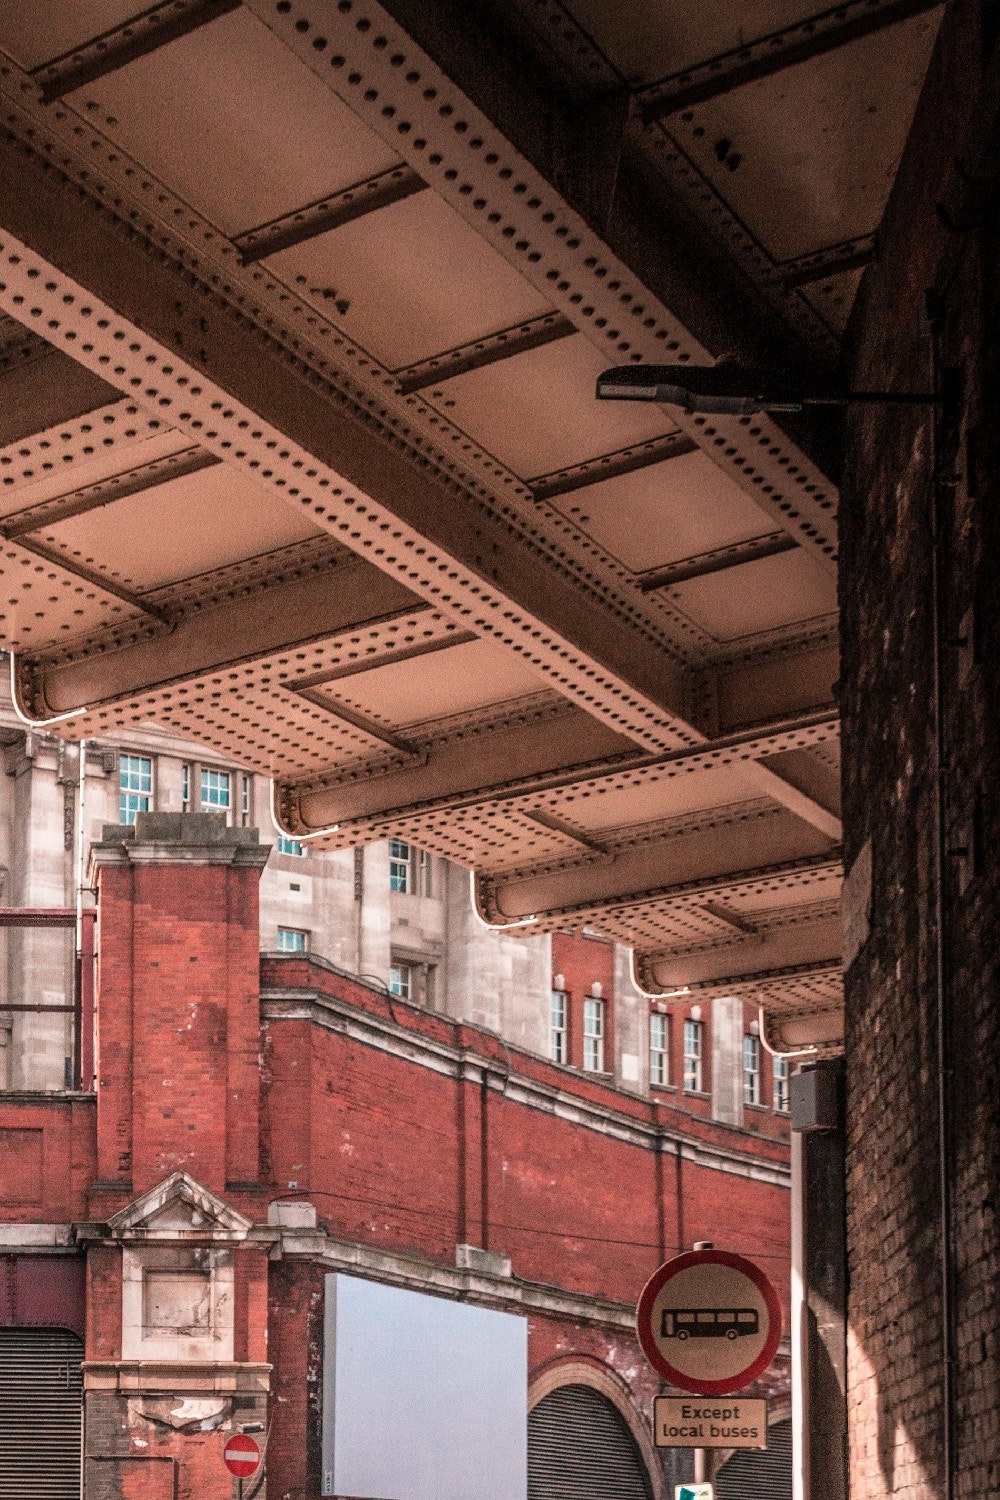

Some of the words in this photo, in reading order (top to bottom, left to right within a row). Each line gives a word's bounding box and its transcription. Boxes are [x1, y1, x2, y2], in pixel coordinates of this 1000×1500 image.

[681, 1405, 740, 1421] Except
[663, 1423, 704, 1437] local
[710, 1424, 759, 1438] buses
